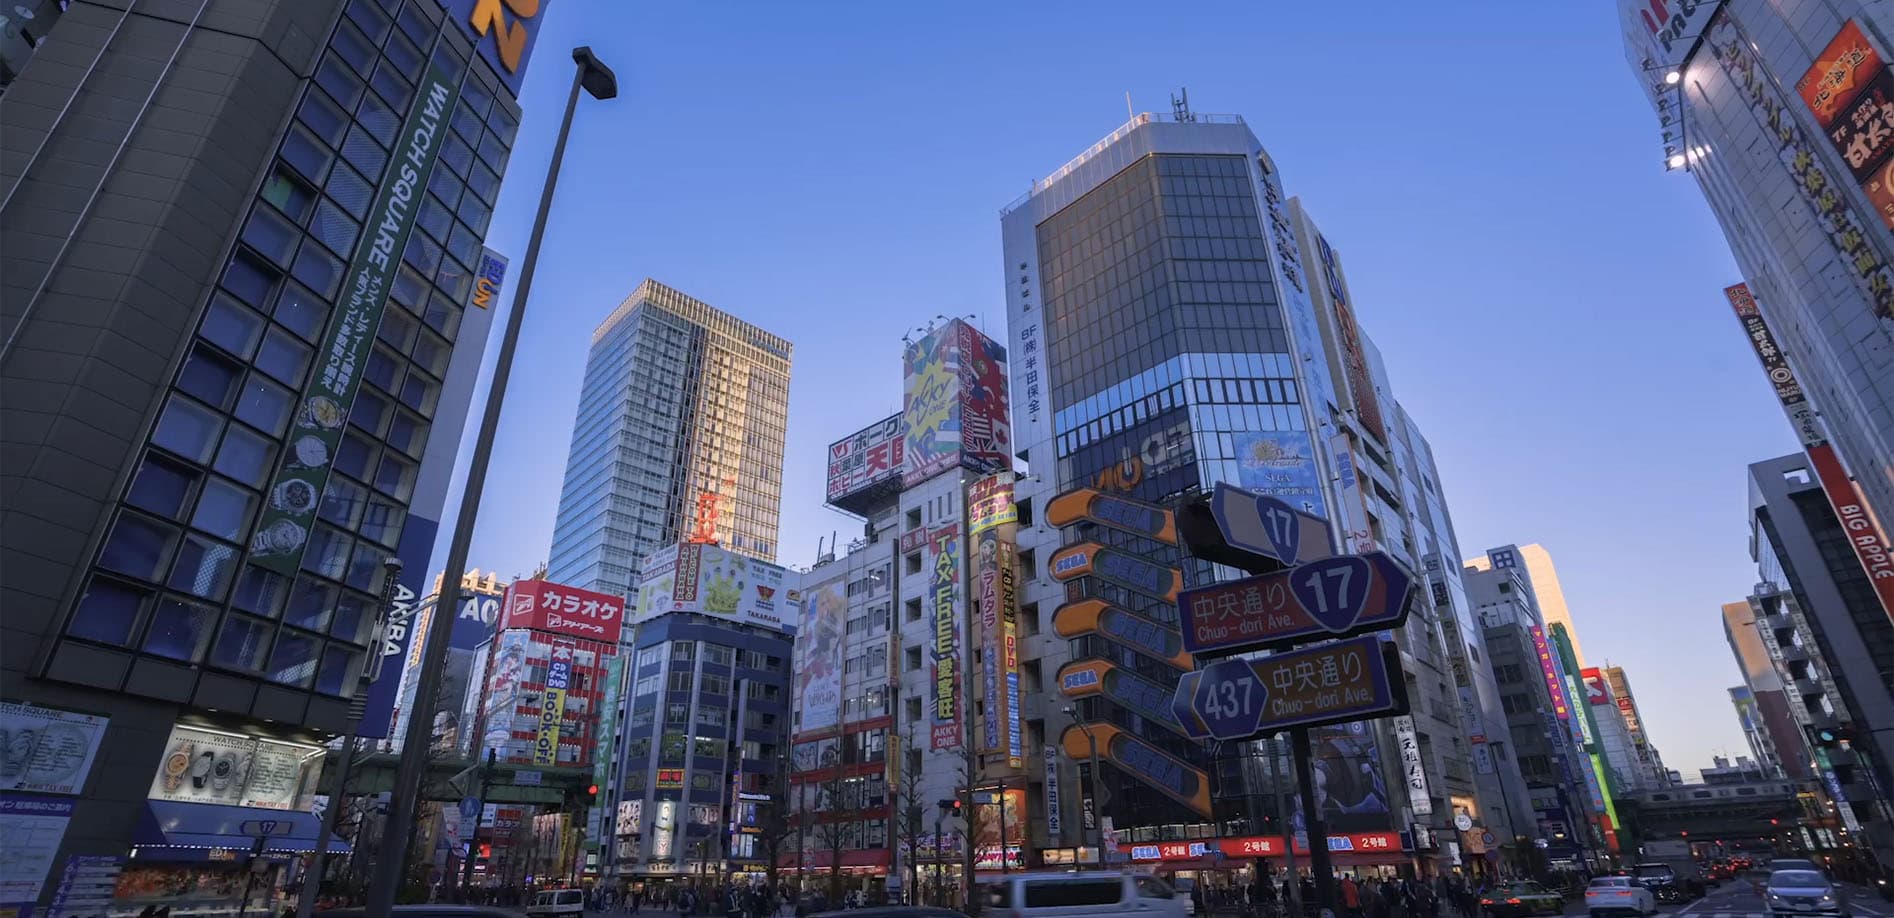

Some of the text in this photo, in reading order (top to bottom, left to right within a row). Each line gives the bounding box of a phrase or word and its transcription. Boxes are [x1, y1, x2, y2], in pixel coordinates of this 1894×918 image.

[367, 82, 449, 272] WATCH SQUARE
[1099, 502, 1150, 525] SEGA
[1266, 507, 1292, 547] 17
[1840, 504, 1894, 579] BIG APPLE
[685, 545, 700, 600] WELCOME TO
[1055, 552, 1088, 573] SEGA
[676, 547, 688, 600] AKIHABARA
[1104, 556, 1158, 592] SEGA
[936, 534, 953, 654] TAX FREE
[1304, 565, 1353, 613] 17
[542, 591, 618, 621] カラオケ
[1193, 582, 1286, 624] 中央通り
[383, 583, 415, 656] AKIBA
[747, 609, 781, 625] TAKARADA
[1267, 614, 1295, 630] Ave.
[1109, 613, 1165, 653] SEGA
[552, 645, 571, 660] 本
[549, 670, 568, 680] ゲーム
[552, 662, 567, 671] CD
[1271, 650, 1361, 696] 中央通り
[548, 678, 567, 688] DVD
[1063, 669, 1098, 689] SEGA
[1204, 676, 1254, 721] 437
[1344, 687, 1373, 704] Ave.
[213, 735, 241, 746] WATCH
[934, 724, 958, 737] AKKY
[936, 736, 956, 747] ONE
[1123, 742, 1182, 793] SEGA
[262, 822, 274, 833] 17
[1131, 845, 1161, 859] SEGA
[1164, 845, 1186, 856] 2号館
[1243, 841, 1271, 853] 2号館
[1362, 837, 1388, 849] 2号館
